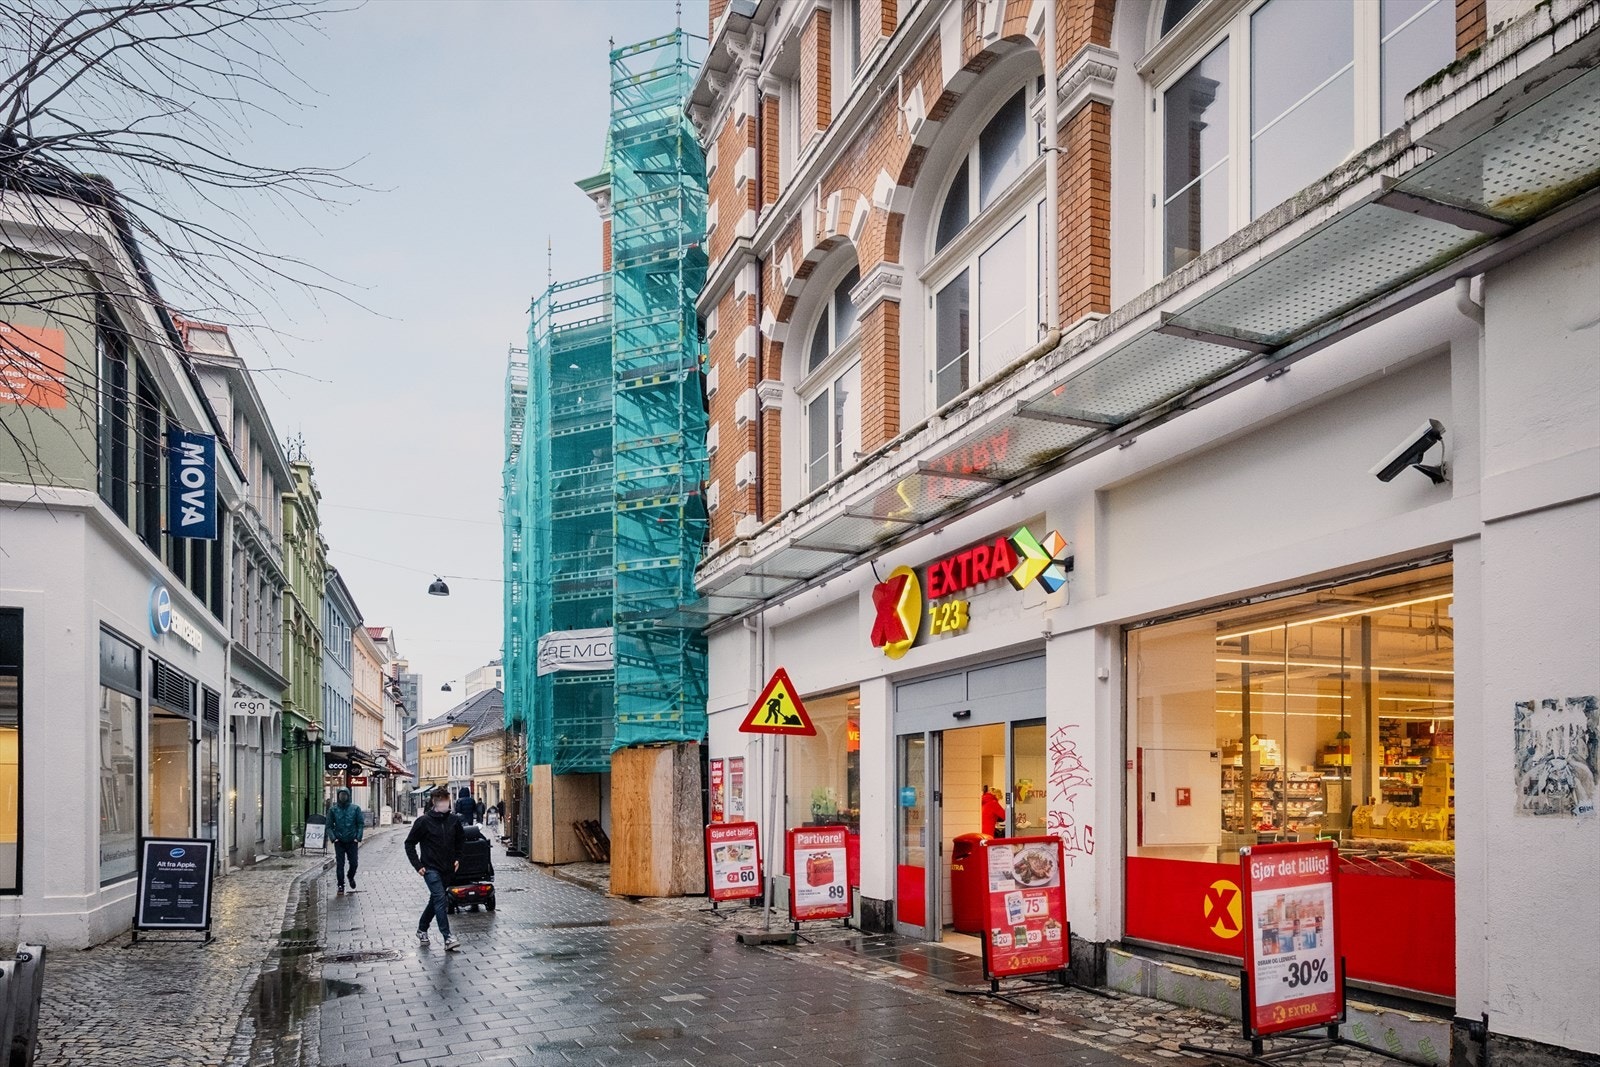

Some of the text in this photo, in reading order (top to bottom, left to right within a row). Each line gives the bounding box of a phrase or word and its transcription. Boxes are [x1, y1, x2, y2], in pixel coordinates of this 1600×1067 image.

[180, 441, 206, 527] MOVA
[928, 537, 1014, 599] EXTRA
[929, 600, 965, 635] 7-23
[234, 701, 265, 714] regn
[797, 832, 842, 845] Partivare!
[1251, 855, 1329, 882] Gjør det billig!
[740, 870, 755, 882] 60
[828, 885, 844, 899] 89
[1025, 899, 1040, 913] 75
[998, 936, 1008, 945] 20
[1028, 932, 1038, 941] 29
[1021, 955, 1048, 966] EXTRA
[1282, 957, 1329, 989] -30%
[1288, 1002, 1318, 1017] EXTRA
